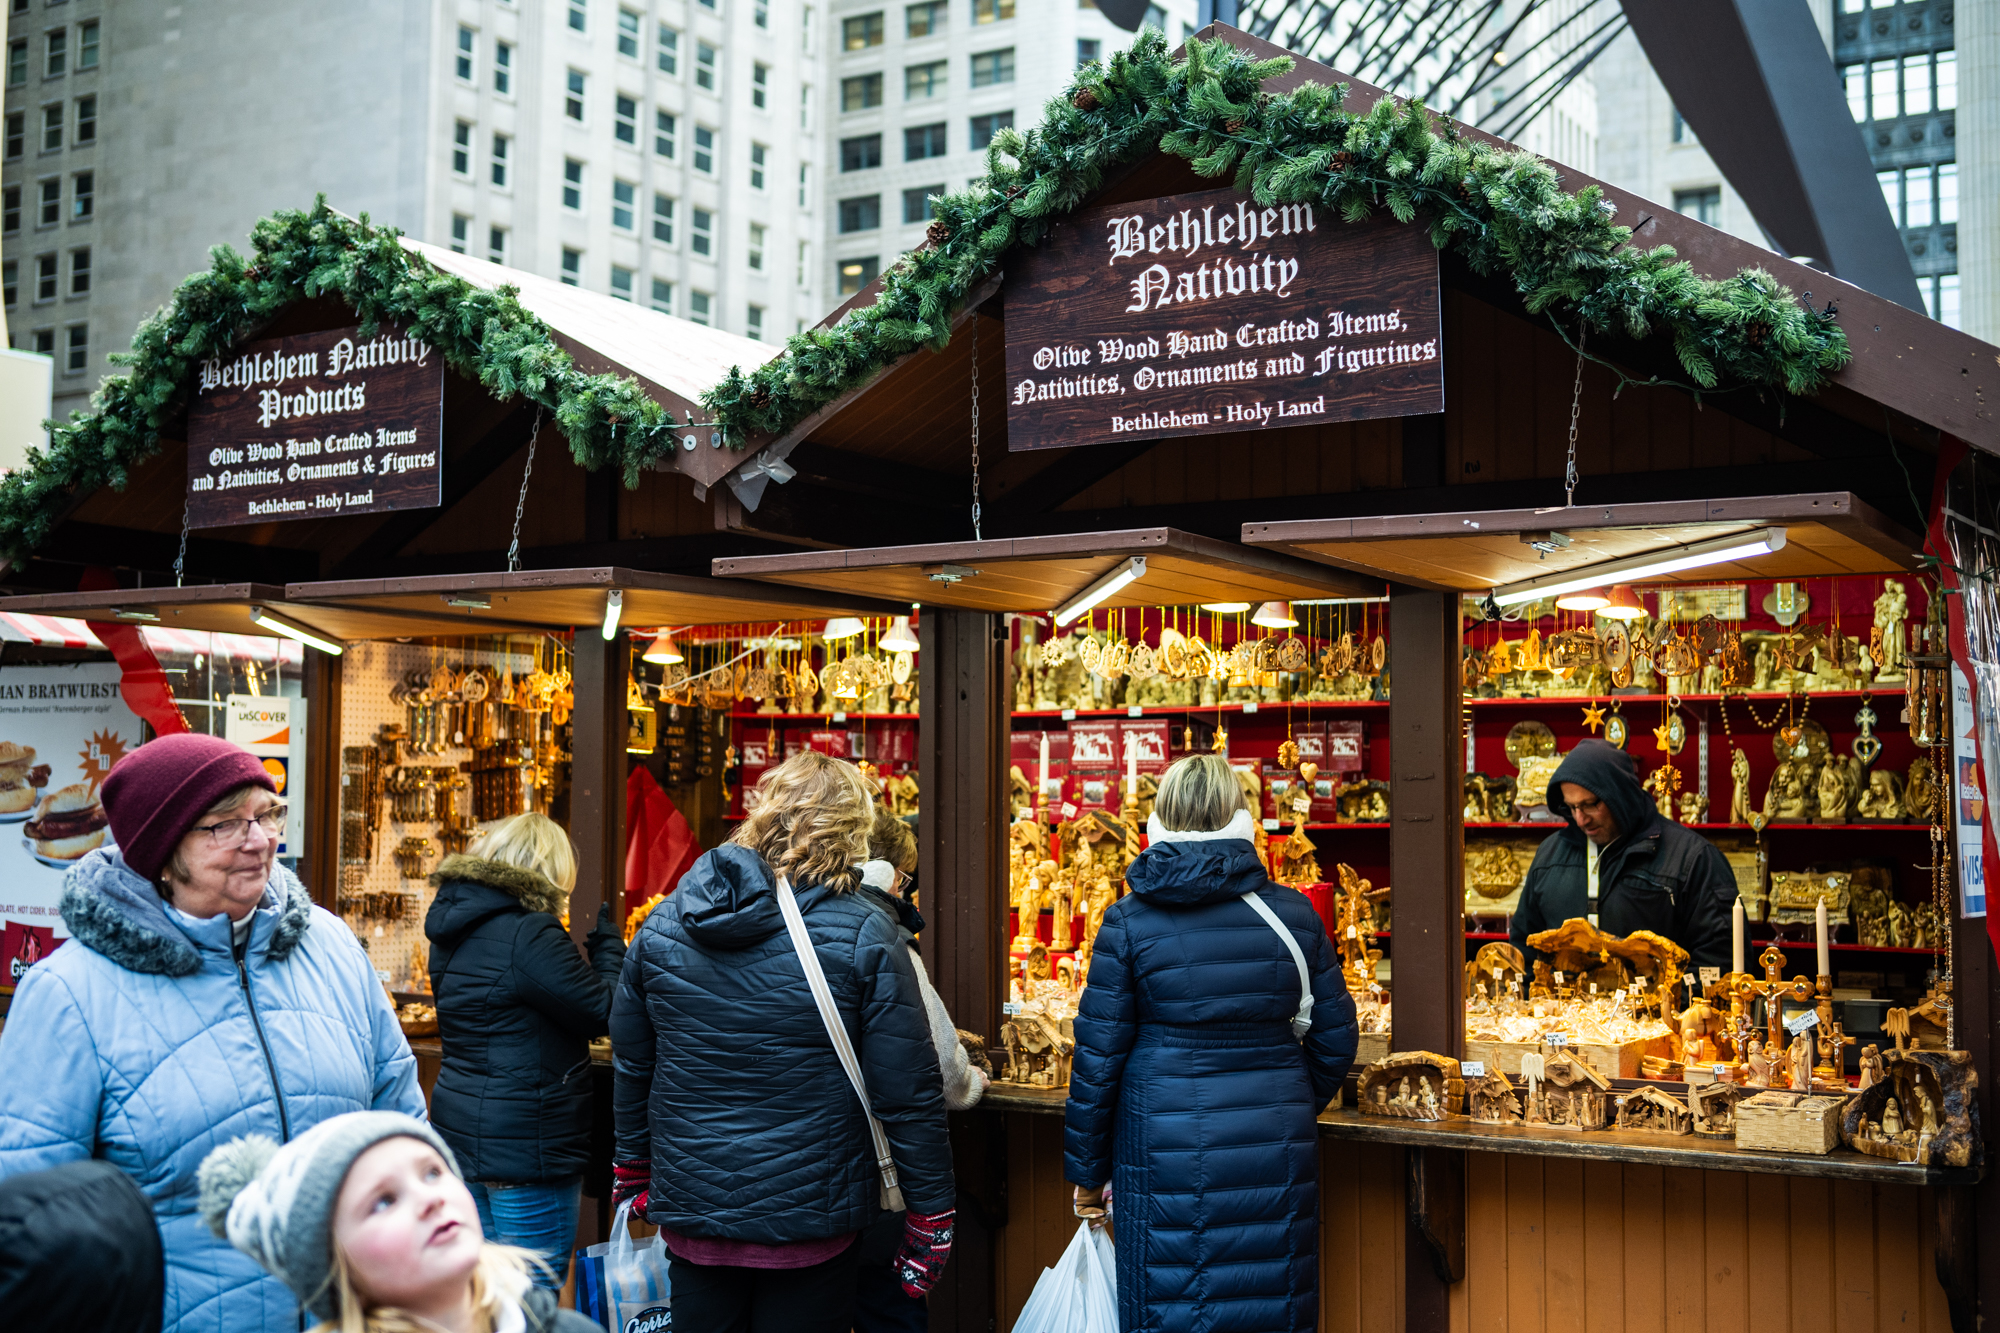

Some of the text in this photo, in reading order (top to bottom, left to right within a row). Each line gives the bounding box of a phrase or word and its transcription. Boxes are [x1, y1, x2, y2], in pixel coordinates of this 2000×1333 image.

[1107, 201, 1317, 266] Bethlehem
[1125, 254, 1300, 313] Nativity
[1033, 308, 1408, 371] Olive Wood Hand Crafted Items,
[198, 332, 432, 396] Bethlehem Nativity
[1011, 337, 1438, 405] Nativities, Ornaments and Figurines
[256, 381, 366, 428] Products
[1111, 407, 1209, 433] Bethlehem
[1226, 402, 1273, 426] Holy
[1277, 396, 1326, 417] Land
[208, 427, 418, 467] Olive Wood Hand Crafted Items
[192, 450, 436, 492] and Nativities, Ornaments & Figures
[248, 496, 306, 515] Bethlehem
[315, 492, 343, 512] Holy
[345, 489, 373, 506] Land
[28, 682, 121, 699] BRATWURST
[18, 906, 29, 914] HOT
